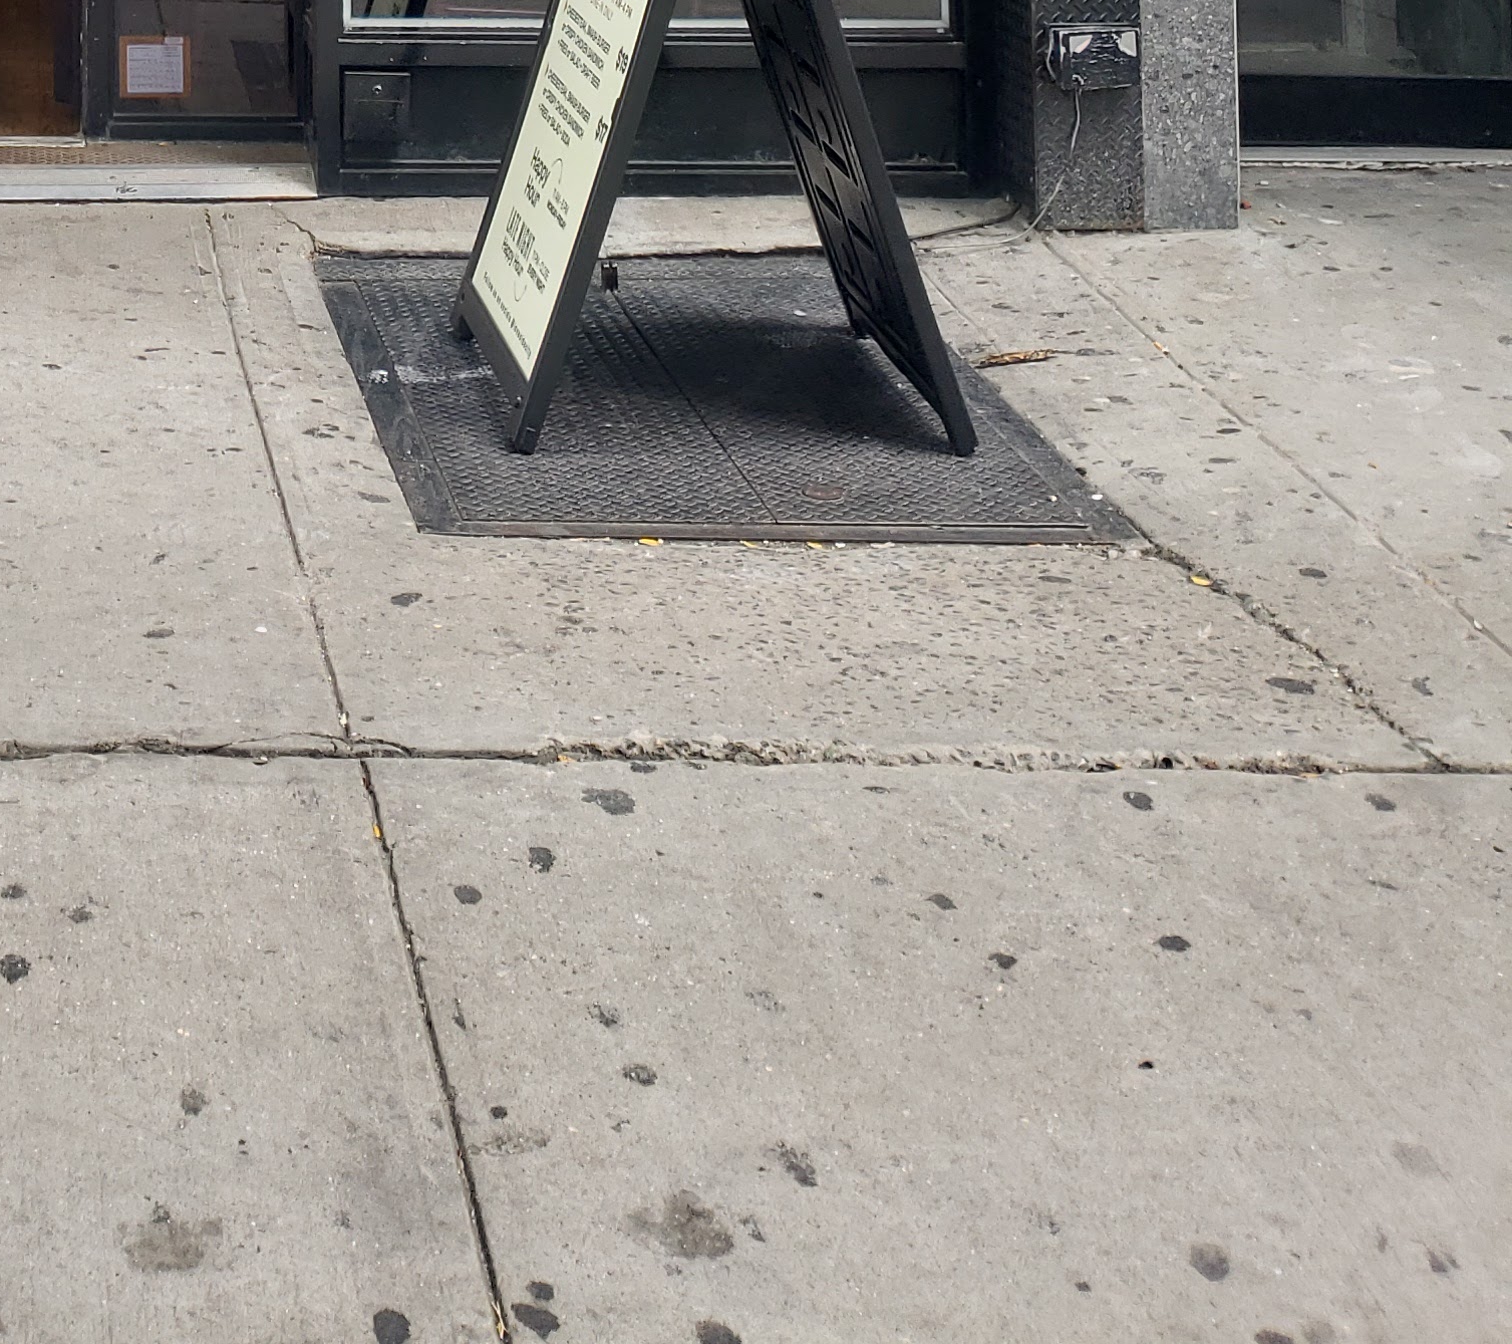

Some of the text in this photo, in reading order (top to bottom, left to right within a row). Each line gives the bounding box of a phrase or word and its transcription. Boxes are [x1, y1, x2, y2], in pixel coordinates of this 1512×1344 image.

[616, 48, 628, 74] $19
[596, 116, 608, 143] $17
[531, 148, 550, 188] Happy
[525, 176, 540, 207] Hour
